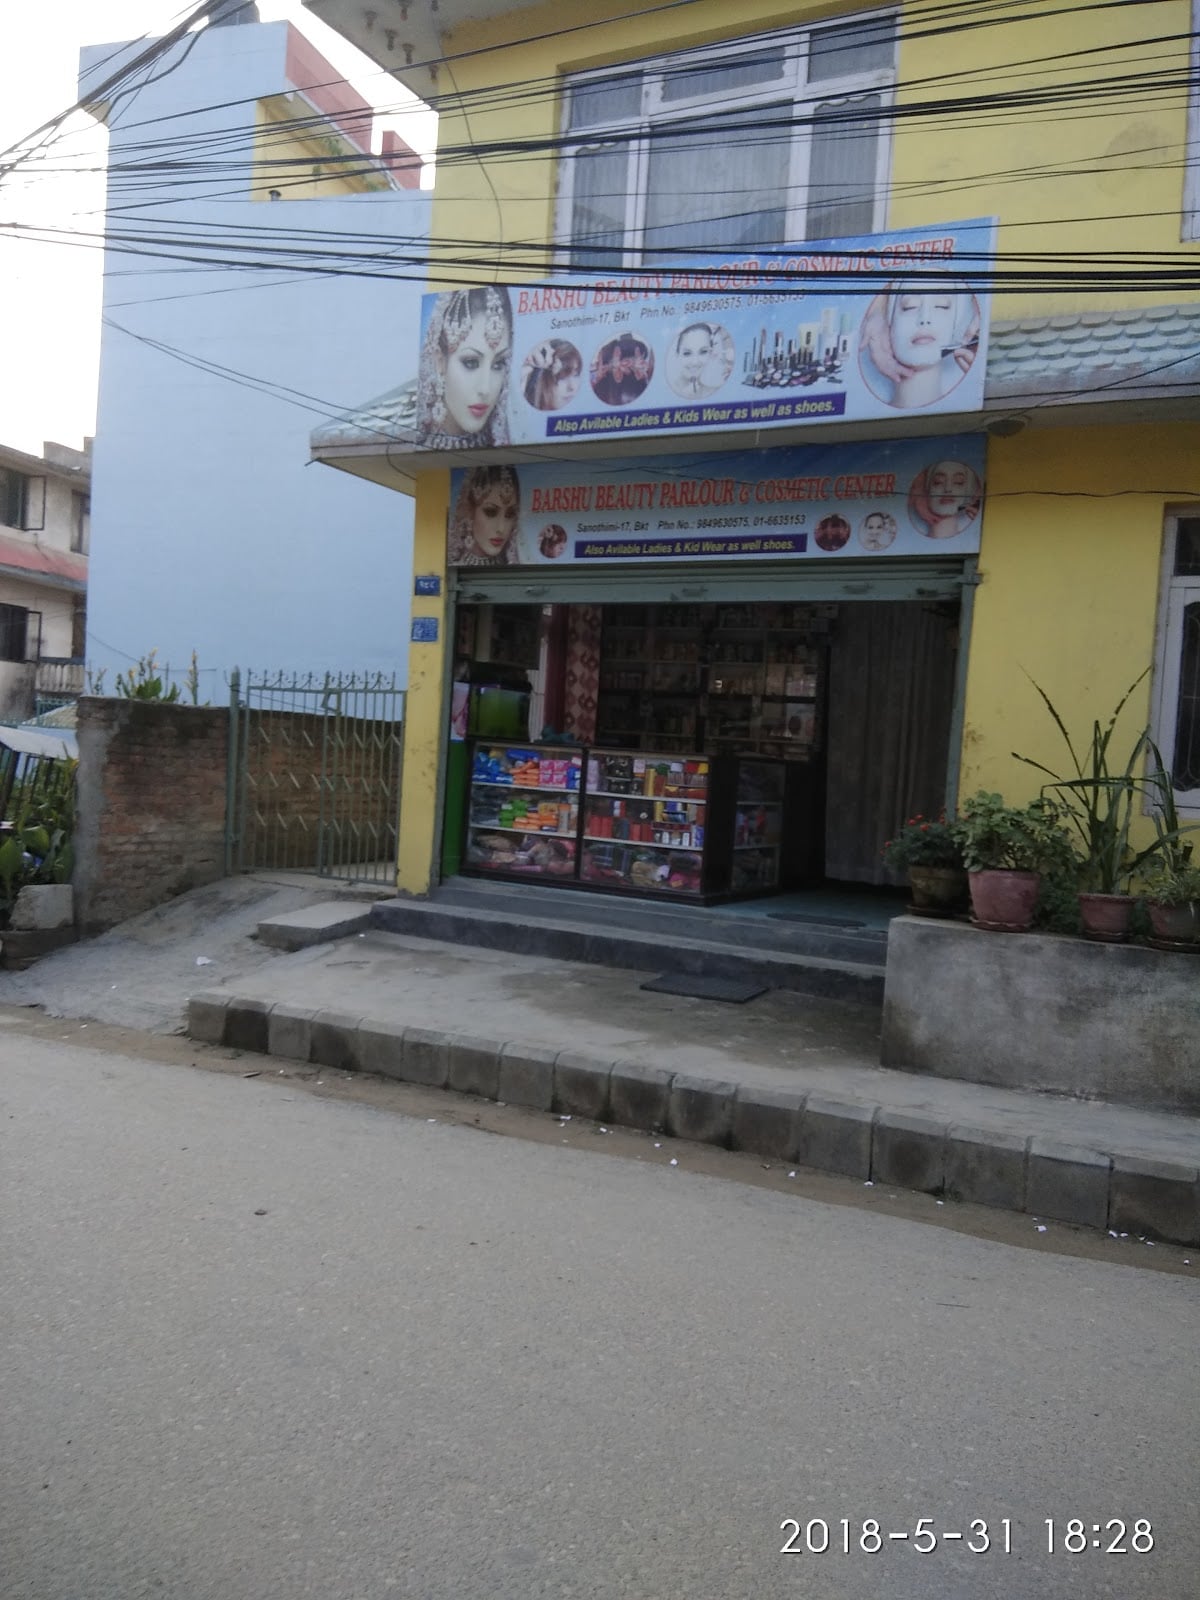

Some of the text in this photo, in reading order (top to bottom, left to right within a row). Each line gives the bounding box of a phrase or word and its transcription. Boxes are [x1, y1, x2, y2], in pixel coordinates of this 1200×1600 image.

[518, 285, 588, 314] BARSHU
[593, 272, 665, 305] BEAUTY
[669, 260, 761, 294] PARLOUR
[782, 248, 875, 281] COSMETIC
[881, 237, 955, 267] CENTER
[640, 307, 659, 319] Phn
[554, 398, 836, 433] Also Avilable Ladies & Kids Wear as well as shoes.
[532, 472, 896, 513] BARSHU BEAUTY PARLOUR & COSMETIC CENTER
[634, 521, 649, 532] Bkt
[657, 520, 675, 530] Phn
[585, 538, 795, 556] Also Avilable Ladies & Kid Wear as well shoes.
